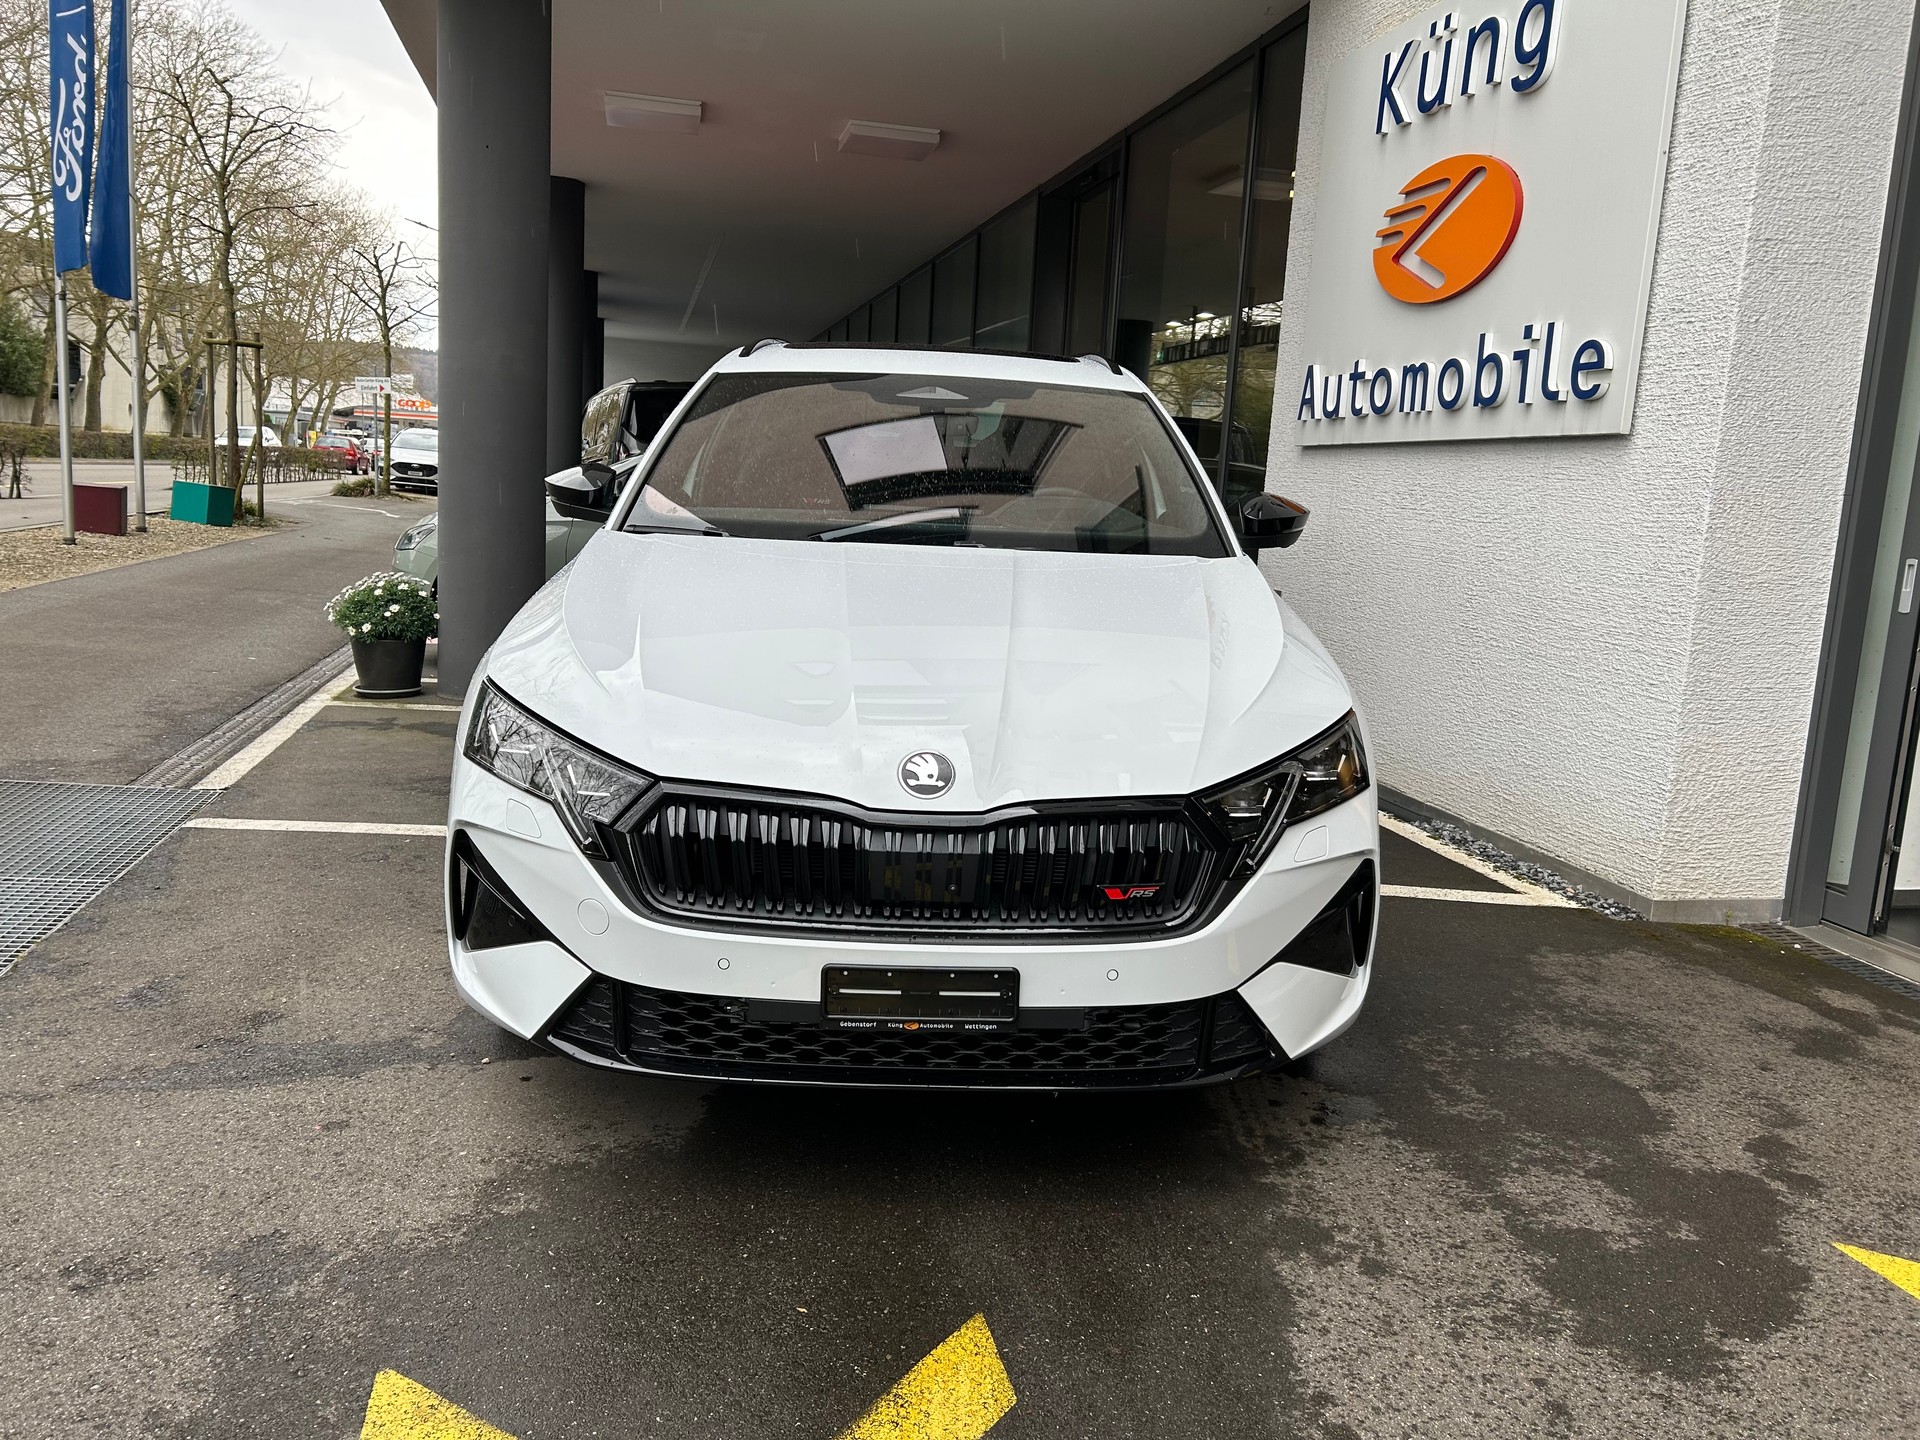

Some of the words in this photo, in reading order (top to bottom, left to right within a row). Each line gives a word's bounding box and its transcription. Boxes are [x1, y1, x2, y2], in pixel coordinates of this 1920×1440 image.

[1376, 0, 1560, 135] Küng
[1297, 321, 1610, 421] Automobile
[964, 1023, 997, 1031] Wettingen
